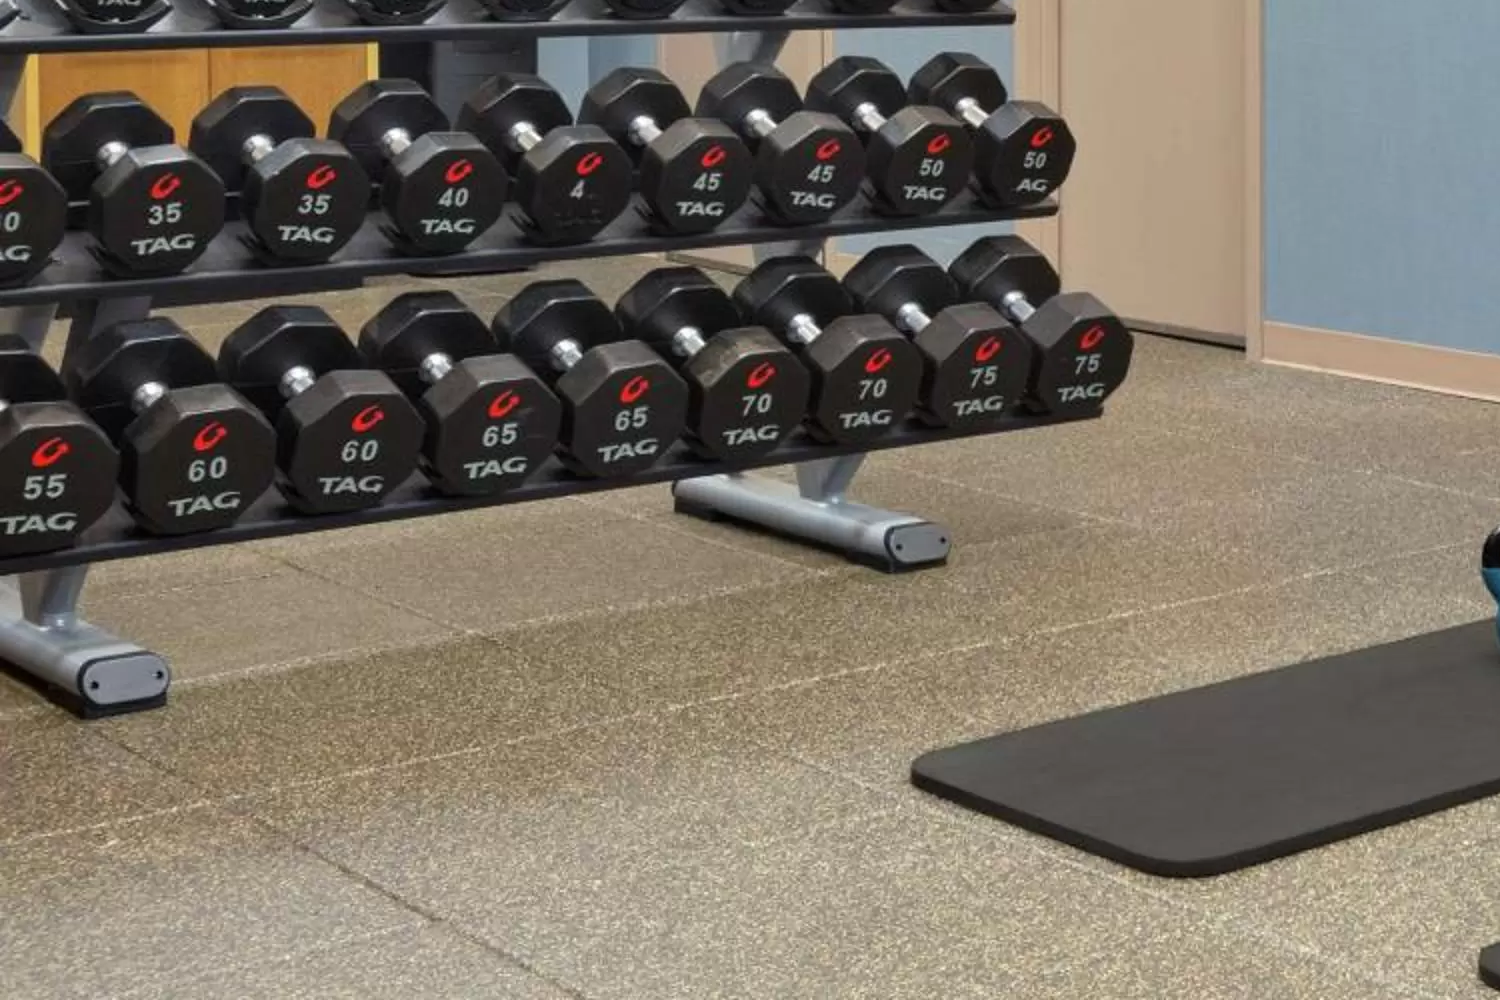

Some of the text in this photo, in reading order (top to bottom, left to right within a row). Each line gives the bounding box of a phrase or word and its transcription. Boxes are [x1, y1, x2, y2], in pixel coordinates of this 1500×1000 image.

[919, 158, 945, 177] 50
[1023, 151, 1047, 169] 50
[693, 172, 722, 191] 45
[807, 164, 836, 183] 45
[438, 187, 469, 208] 40
[790, 191, 835, 209] TAG
[903, 185, 945, 201] TAG
[148, 202, 182, 225] 35
[297, 194, 332, 215] 35
[676, 201, 724, 217] TAG
[278, 225, 334, 244] TAG
[420, 218, 475, 235] TAG
[130, 233, 195, 256] TAG
[1075, 353, 1101, 375] 75
[970, 365, 999, 389] 75
[859, 378, 888, 400] 70
[1057, 382, 1105, 404] TAG
[742, 393, 772, 417] 70
[952, 395, 1003, 417] TAG
[614, 405, 649, 431] 65
[839, 409, 891, 429] TAG
[482, 422, 518, 447] 65
[722, 424, 779, 446] TAG
[341, 439, 379, 462] 60
[597, 438, 658, 463] TAG
[188, 456, 227, 483] 60
[463, 456, 527, 479] TAG
[23, 473, 67, 500] 55
[319, 475, 383, 495] TAG
[167, 491, 241, 517] TAG
[0, 512, 77, 535] TAG
